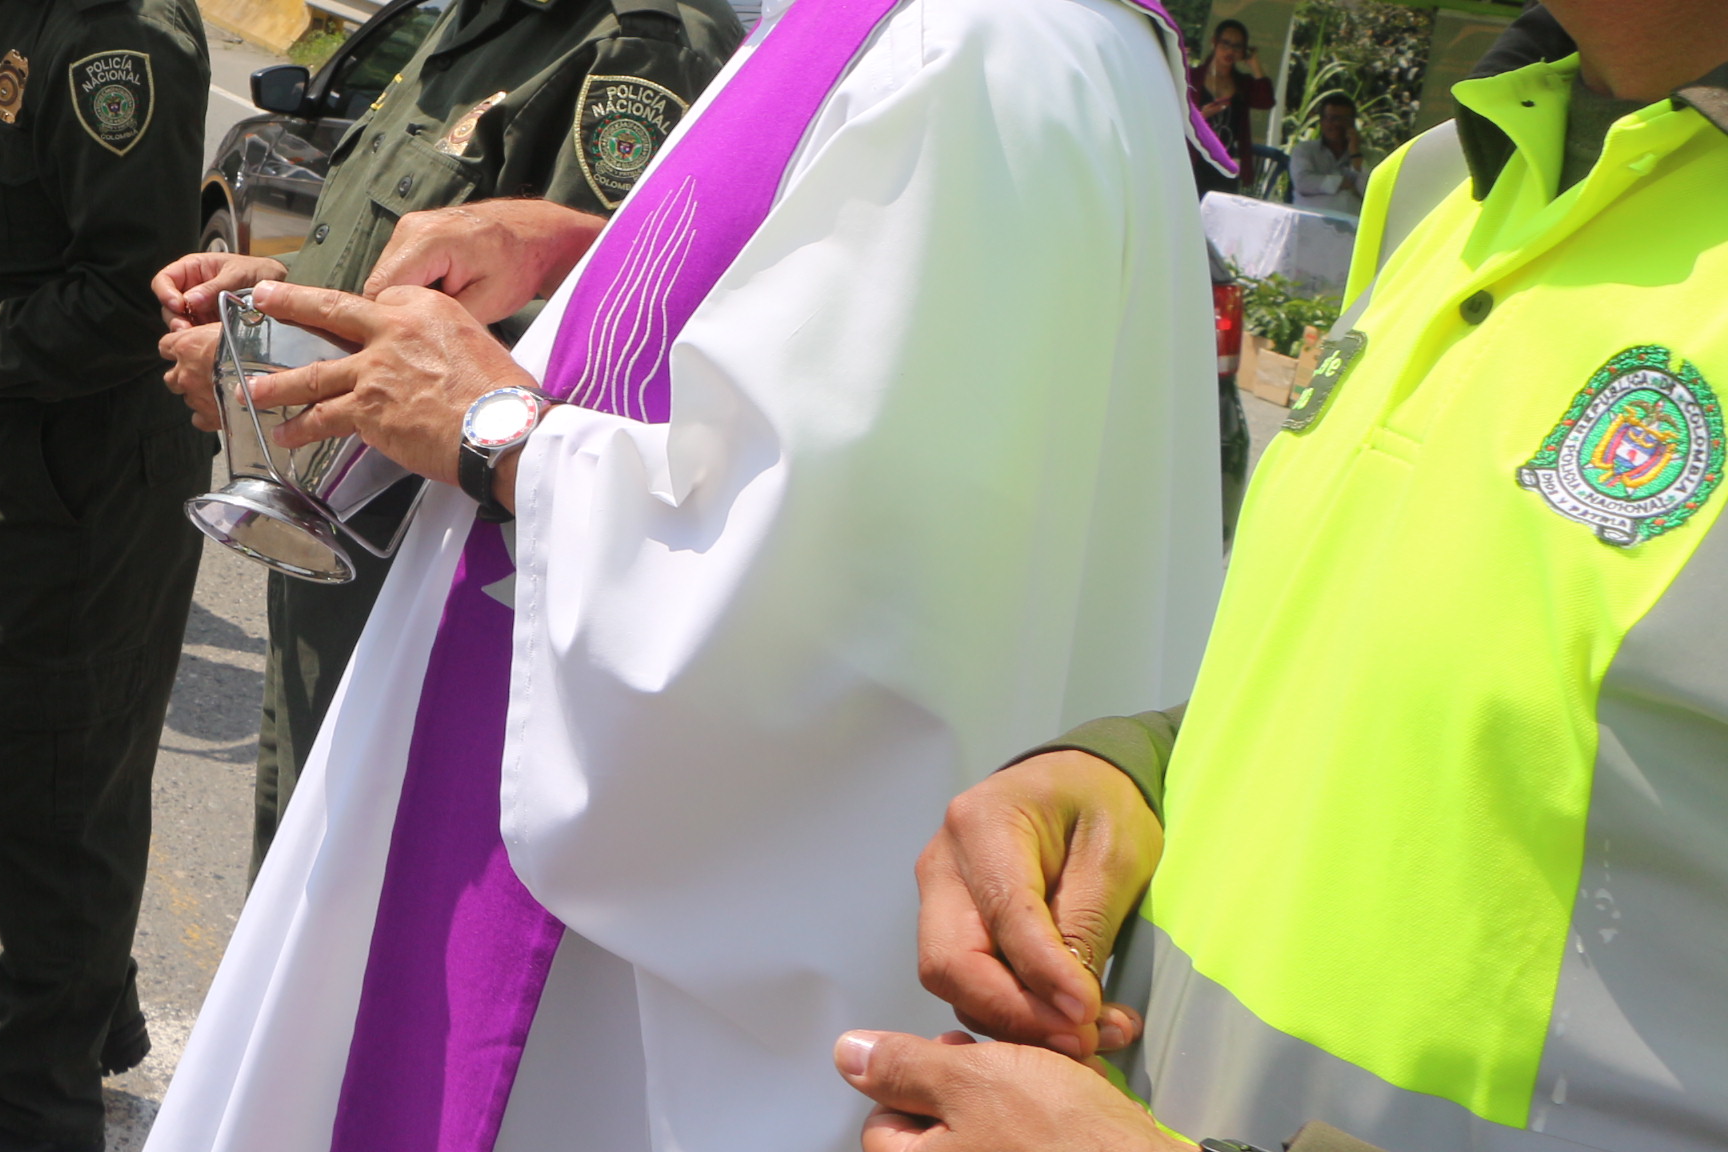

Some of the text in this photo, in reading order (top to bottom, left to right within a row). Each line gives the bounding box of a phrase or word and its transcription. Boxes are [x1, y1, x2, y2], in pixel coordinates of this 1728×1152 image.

[85, 54, 133, 78] POLICÍA
[82, 70, 141, 93] NACIONAL
[606, 84, 667, 114] POLICÍA
[591, 99, 671, 136] NACIONAL
[100, 128, 139, 141] COLOMBIA
[593, 173, 632, 190] COLOMB
[1660, 376, 1677, 395] DE
[1674, 401, 1706, 494] COLOMBIA
[1559, 443, 1668, 515] POLICIA NACIONAL
[1541, 472, 1559, 495] DIOS
[1570, 504, 1628, 528] PATRIA
